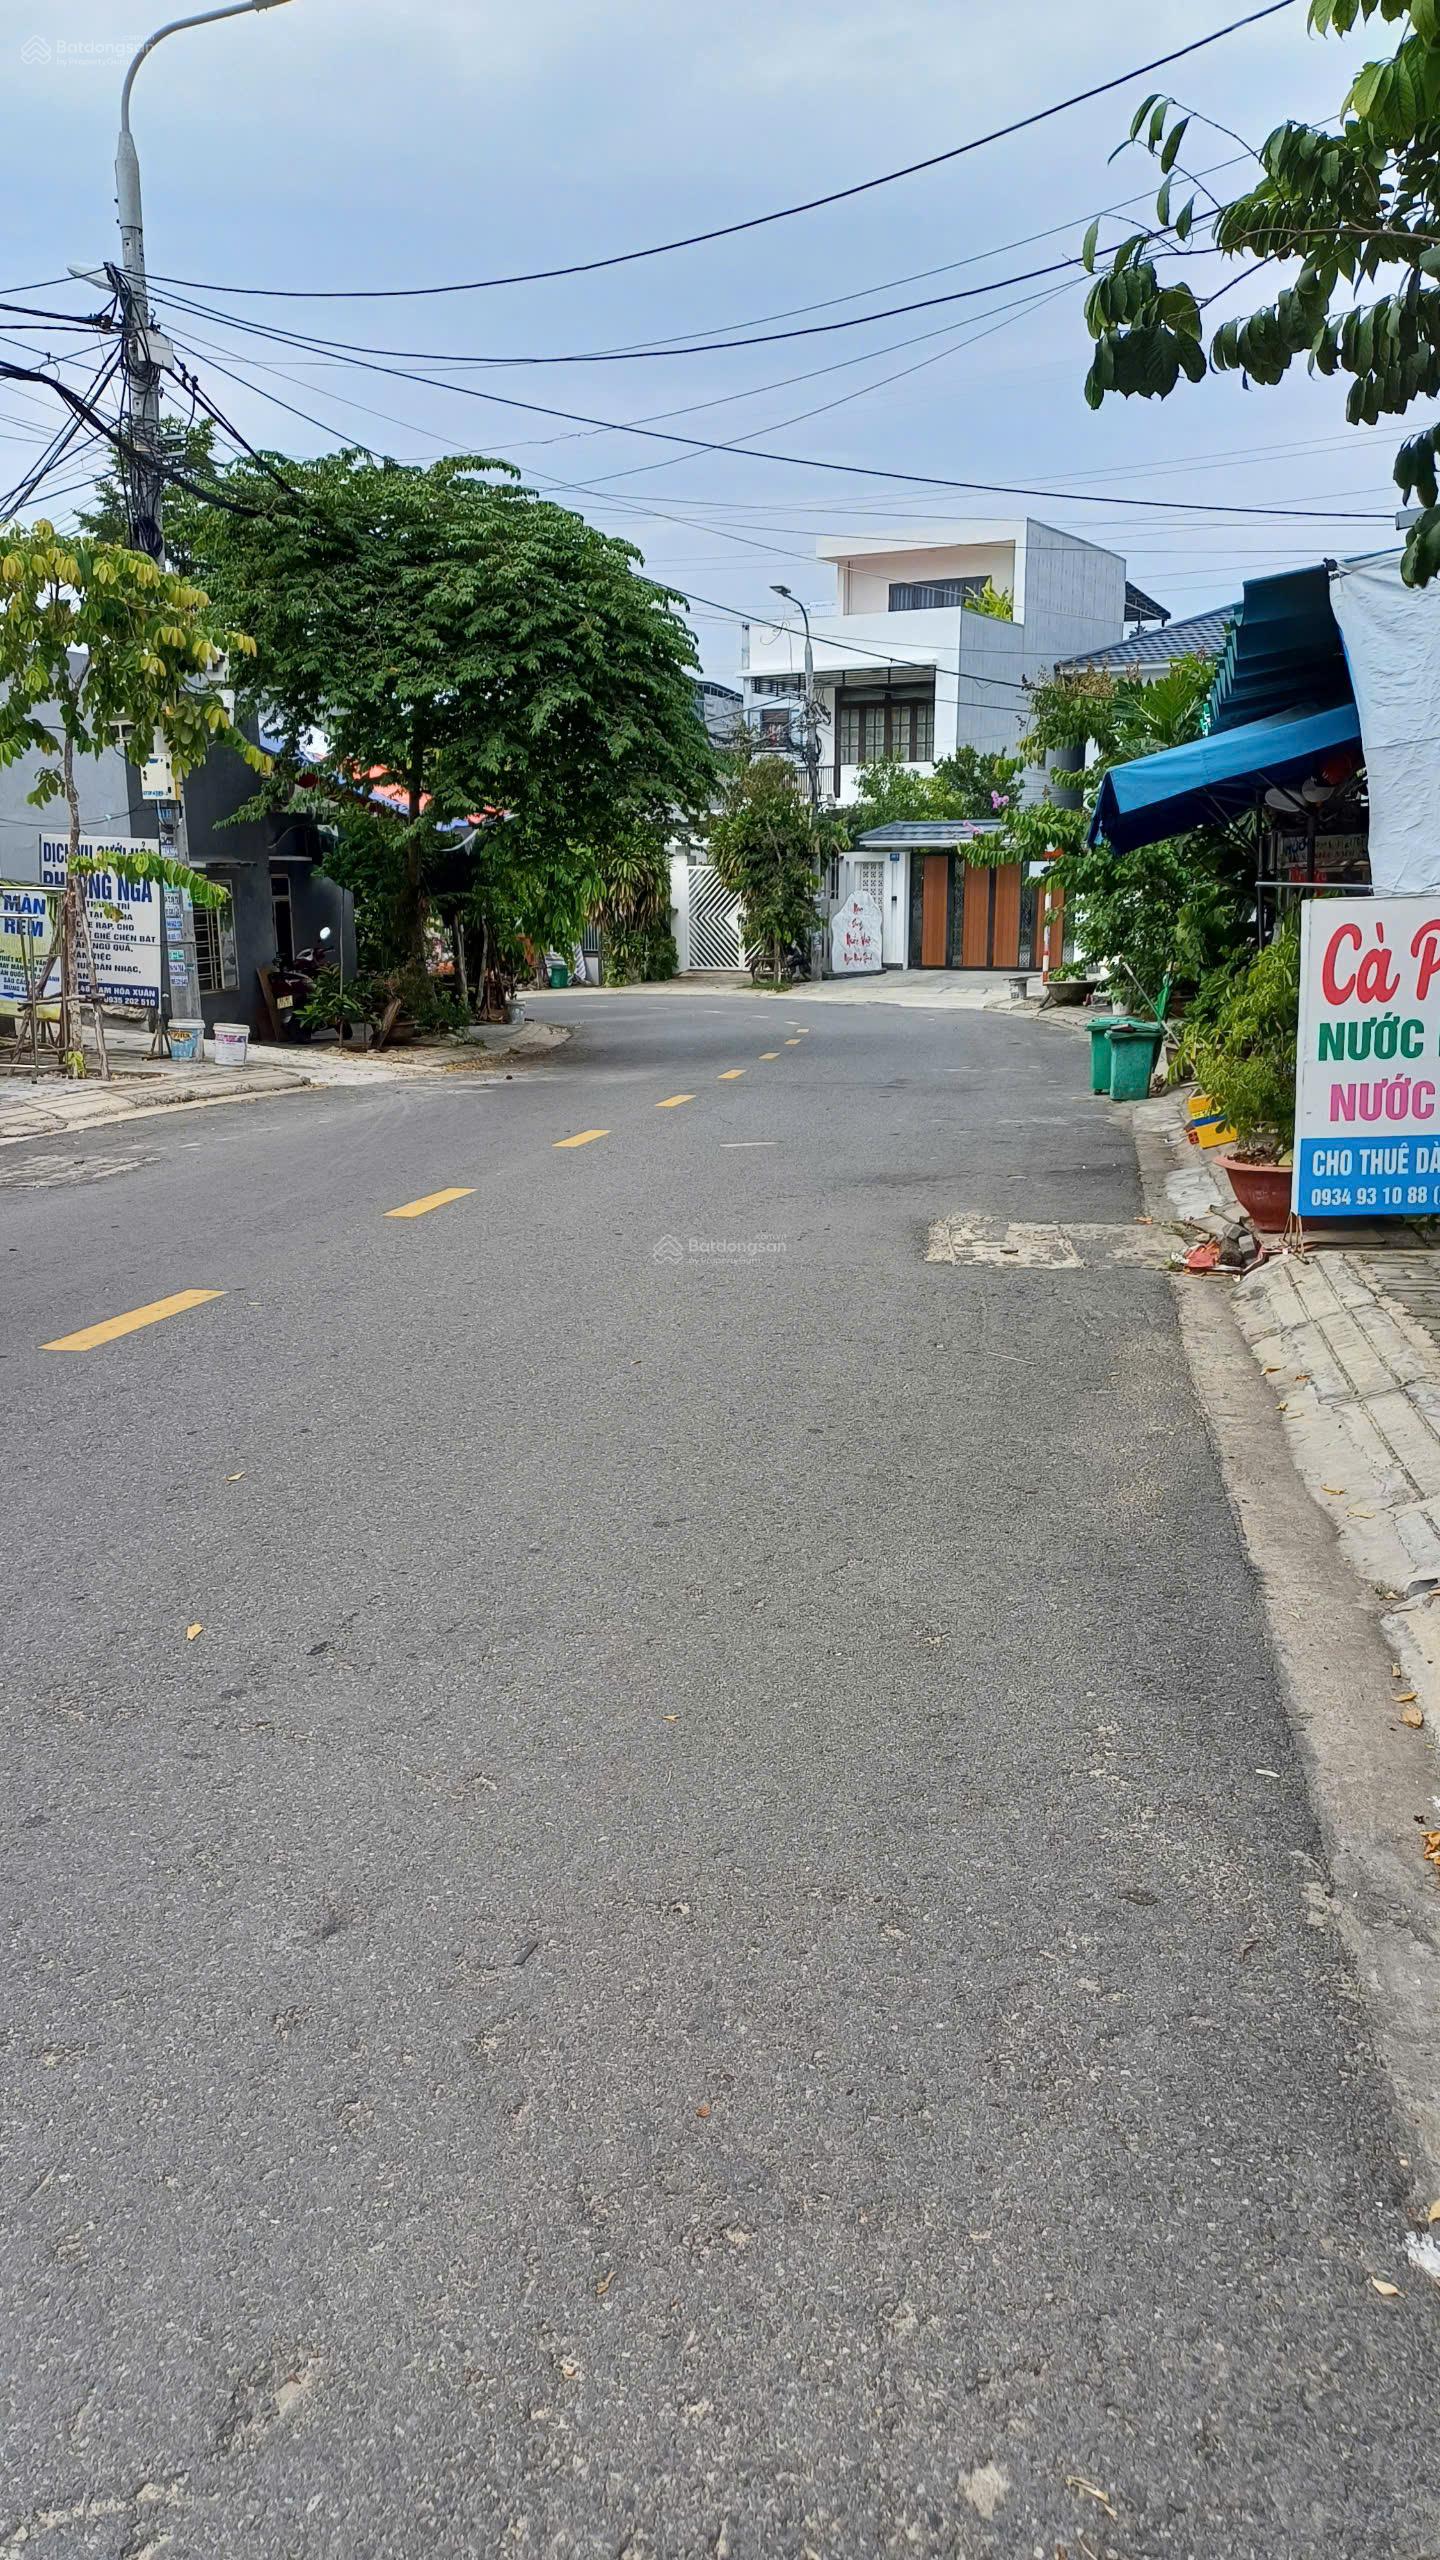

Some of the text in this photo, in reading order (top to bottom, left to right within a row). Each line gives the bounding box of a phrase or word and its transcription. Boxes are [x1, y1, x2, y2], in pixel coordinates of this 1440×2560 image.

[4, 893, 46, 915] MÀN
[1322, 922, 1400, 1006] Cà
[124, 997, 139, 1005] 202
[132, 988, 156, 998] XUÂN
[1318, 1011, 1425, 1062] NƯỚC
[1329, 1073, 1436, 1122] NƯỚC
[1312, 1149, 1353, 1177] CHO
[1359, 1142, 1410, 1176] THUÊ
[1311, 1188, 1352, 1207] 0934
[1356, 1187, 1377, 1205] 93
[1382, 1186, 1403, 1204] 10
[1407, 1186, 1428, 1204] 88
